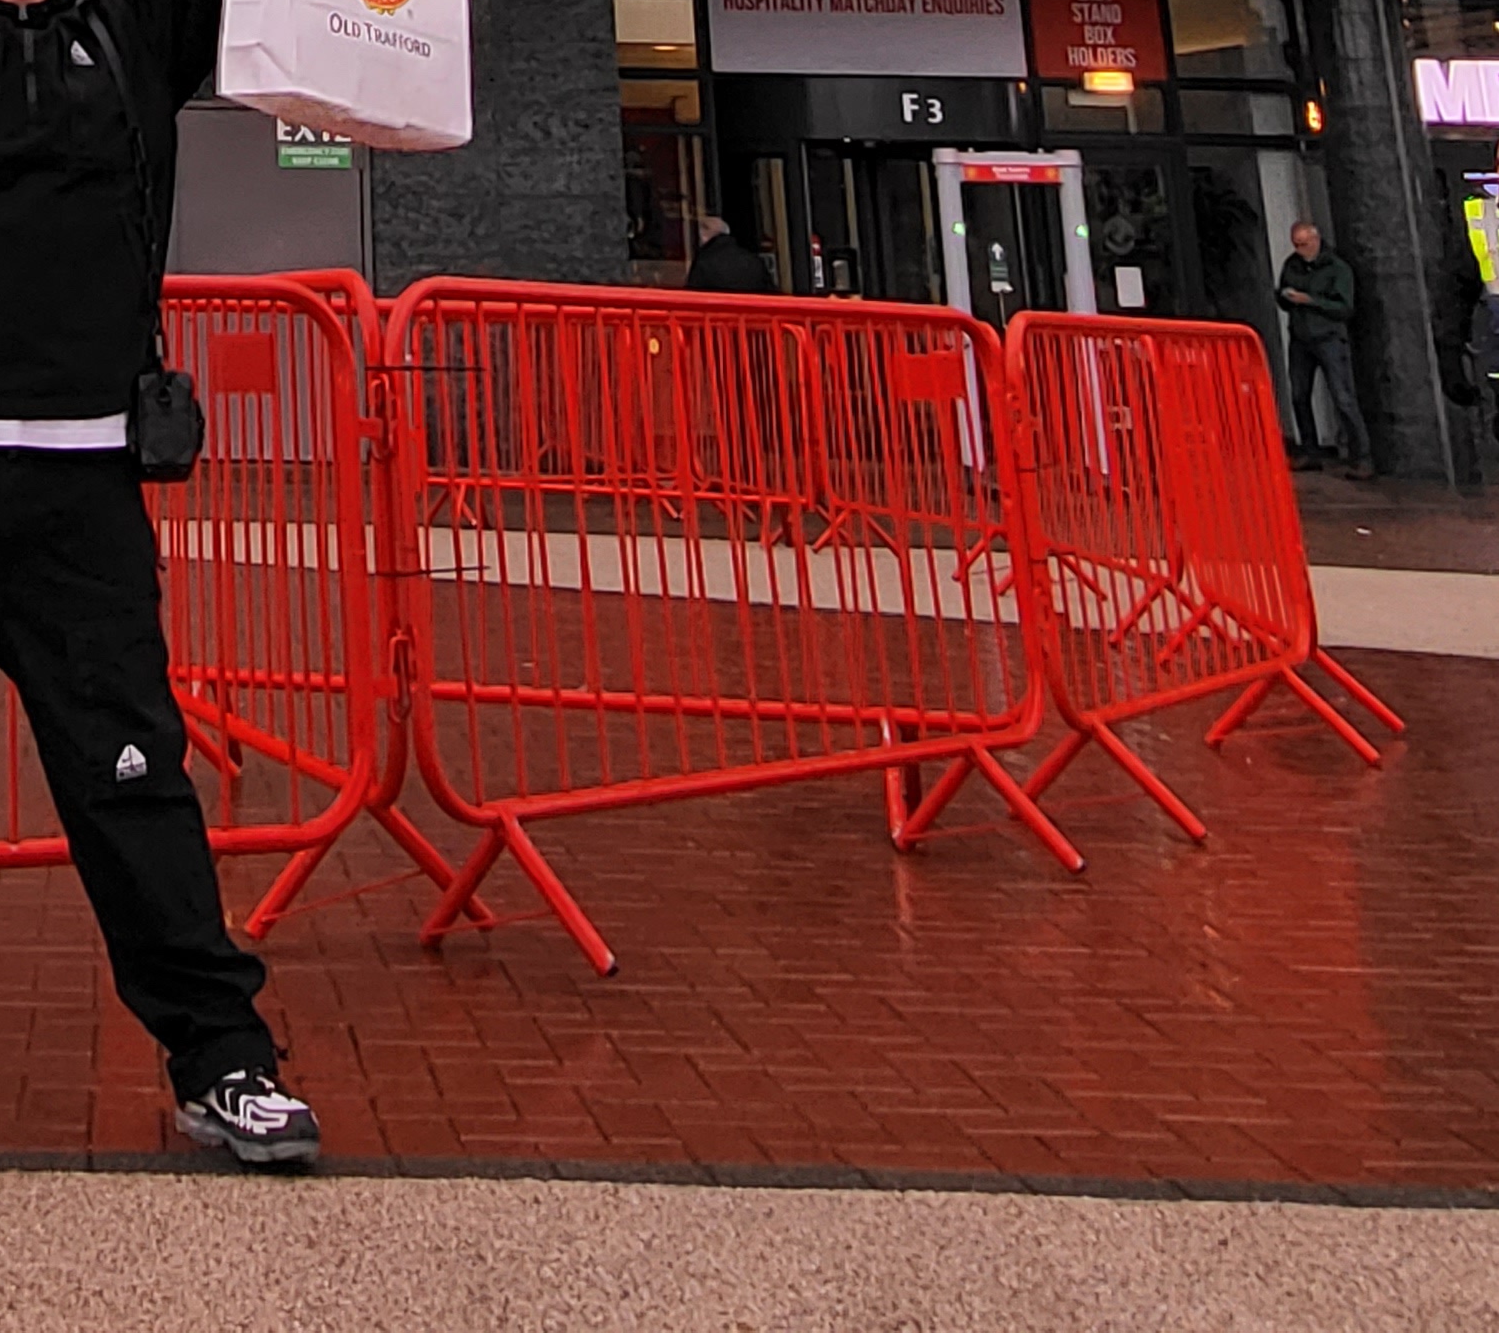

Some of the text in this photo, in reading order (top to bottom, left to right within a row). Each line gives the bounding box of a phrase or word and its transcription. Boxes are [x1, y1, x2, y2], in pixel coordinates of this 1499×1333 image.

[1071, 3, 1122, 24] STAND
[329, 12, 431, 58] OLD TRAFFORD
[1083, 24, 1116, 45] BOX
[1067, 45, 1137, 68] HOLDERS
